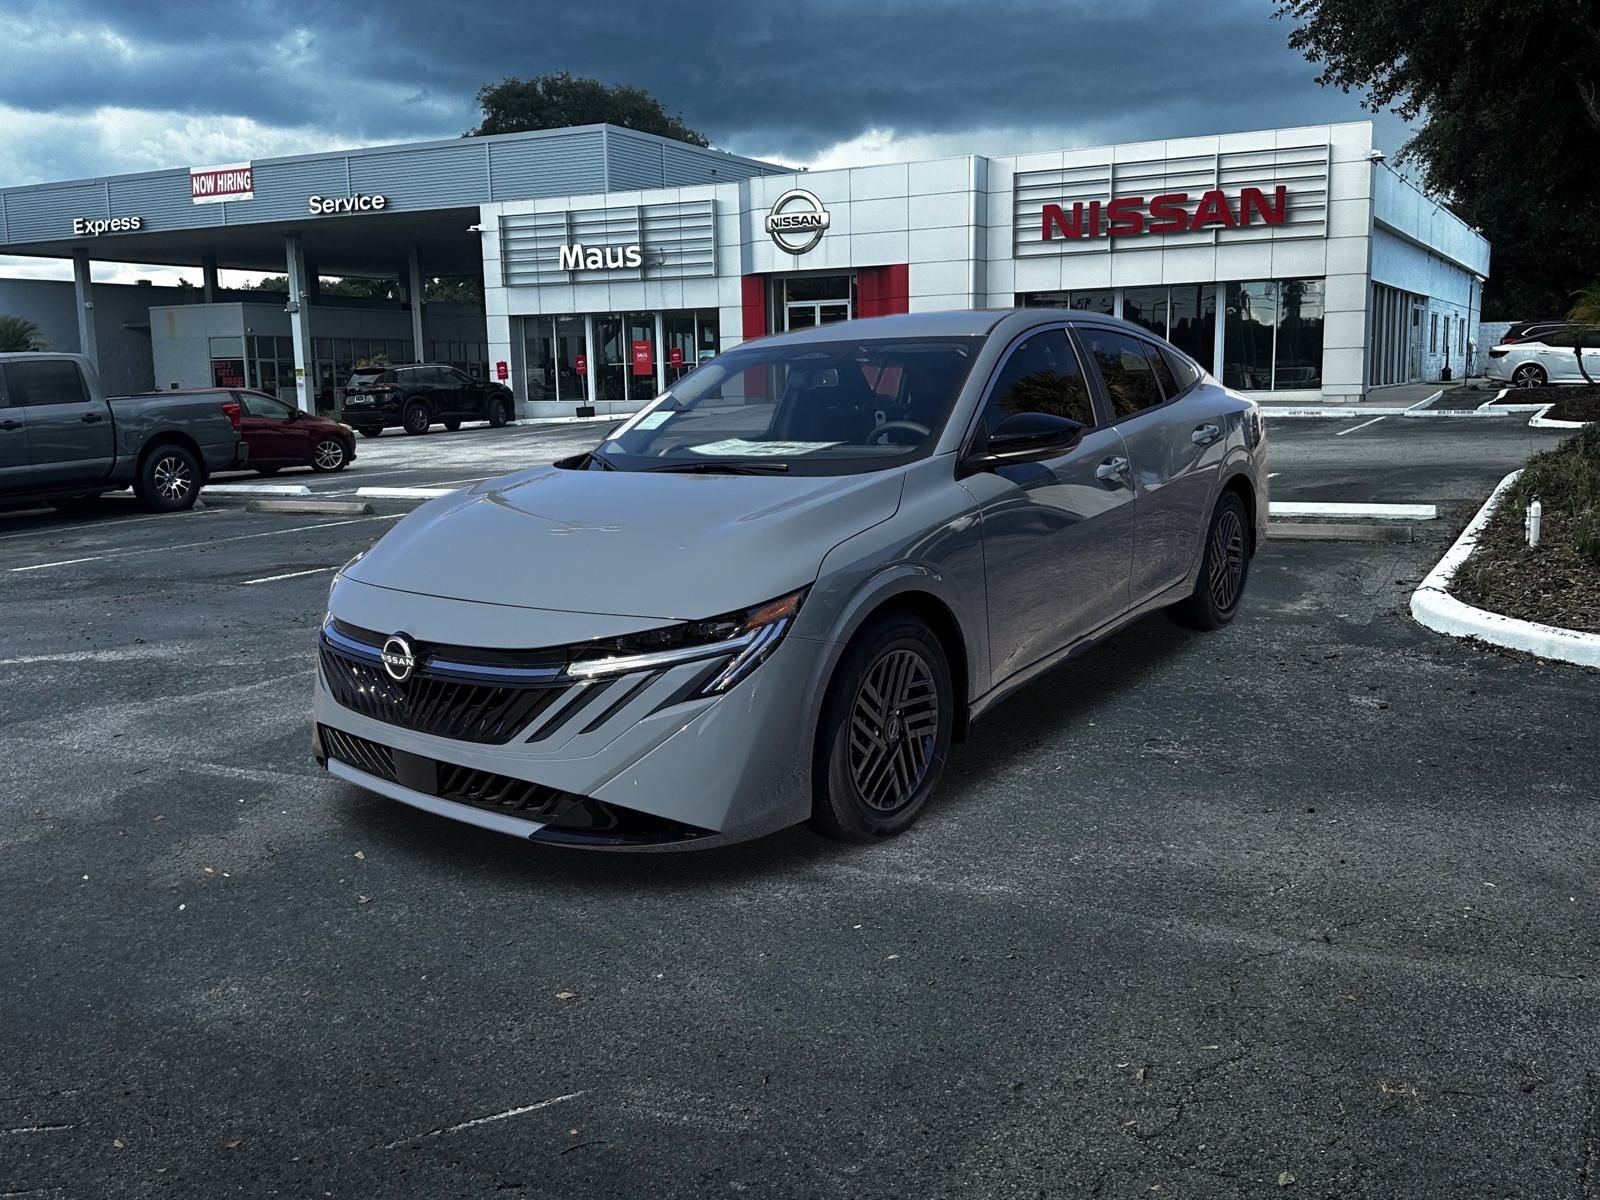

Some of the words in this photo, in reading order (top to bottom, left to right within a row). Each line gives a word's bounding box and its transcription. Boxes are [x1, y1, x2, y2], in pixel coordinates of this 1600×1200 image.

[192, 174, 215, 195] NOW
[217, 171, 251, 192] HIRING
[309, 193, 385, 214] Service
[1042, 185, 1287, 241] NISSAN
[73, 216, 141, 236] Express
[770, 214, 822, 228] NISSAN
[559, 243, 642, 271] Maus
